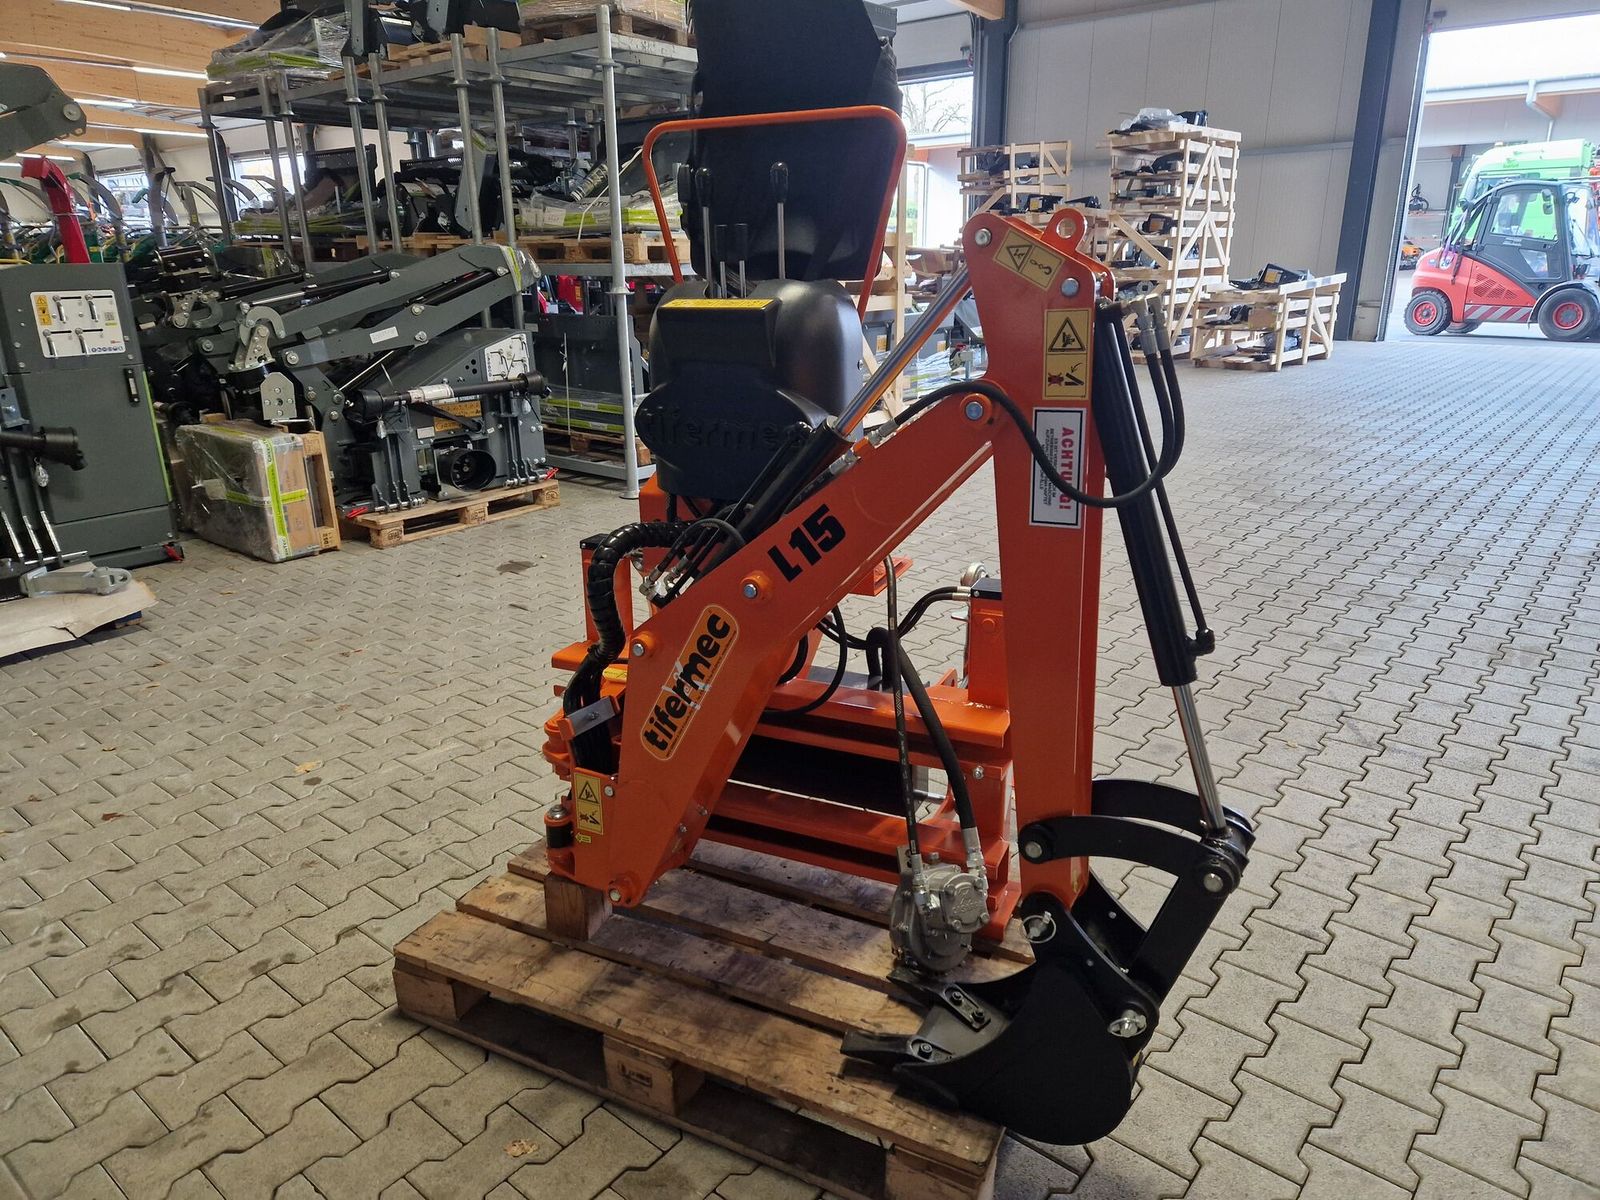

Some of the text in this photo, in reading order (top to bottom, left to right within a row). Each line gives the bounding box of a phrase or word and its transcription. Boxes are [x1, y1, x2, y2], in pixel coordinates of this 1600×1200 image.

[1059, 427, 1074, 510] ACHTUG!
[767, 503, 846, 583] L15
[643, 613, 731, 751] tifermec
